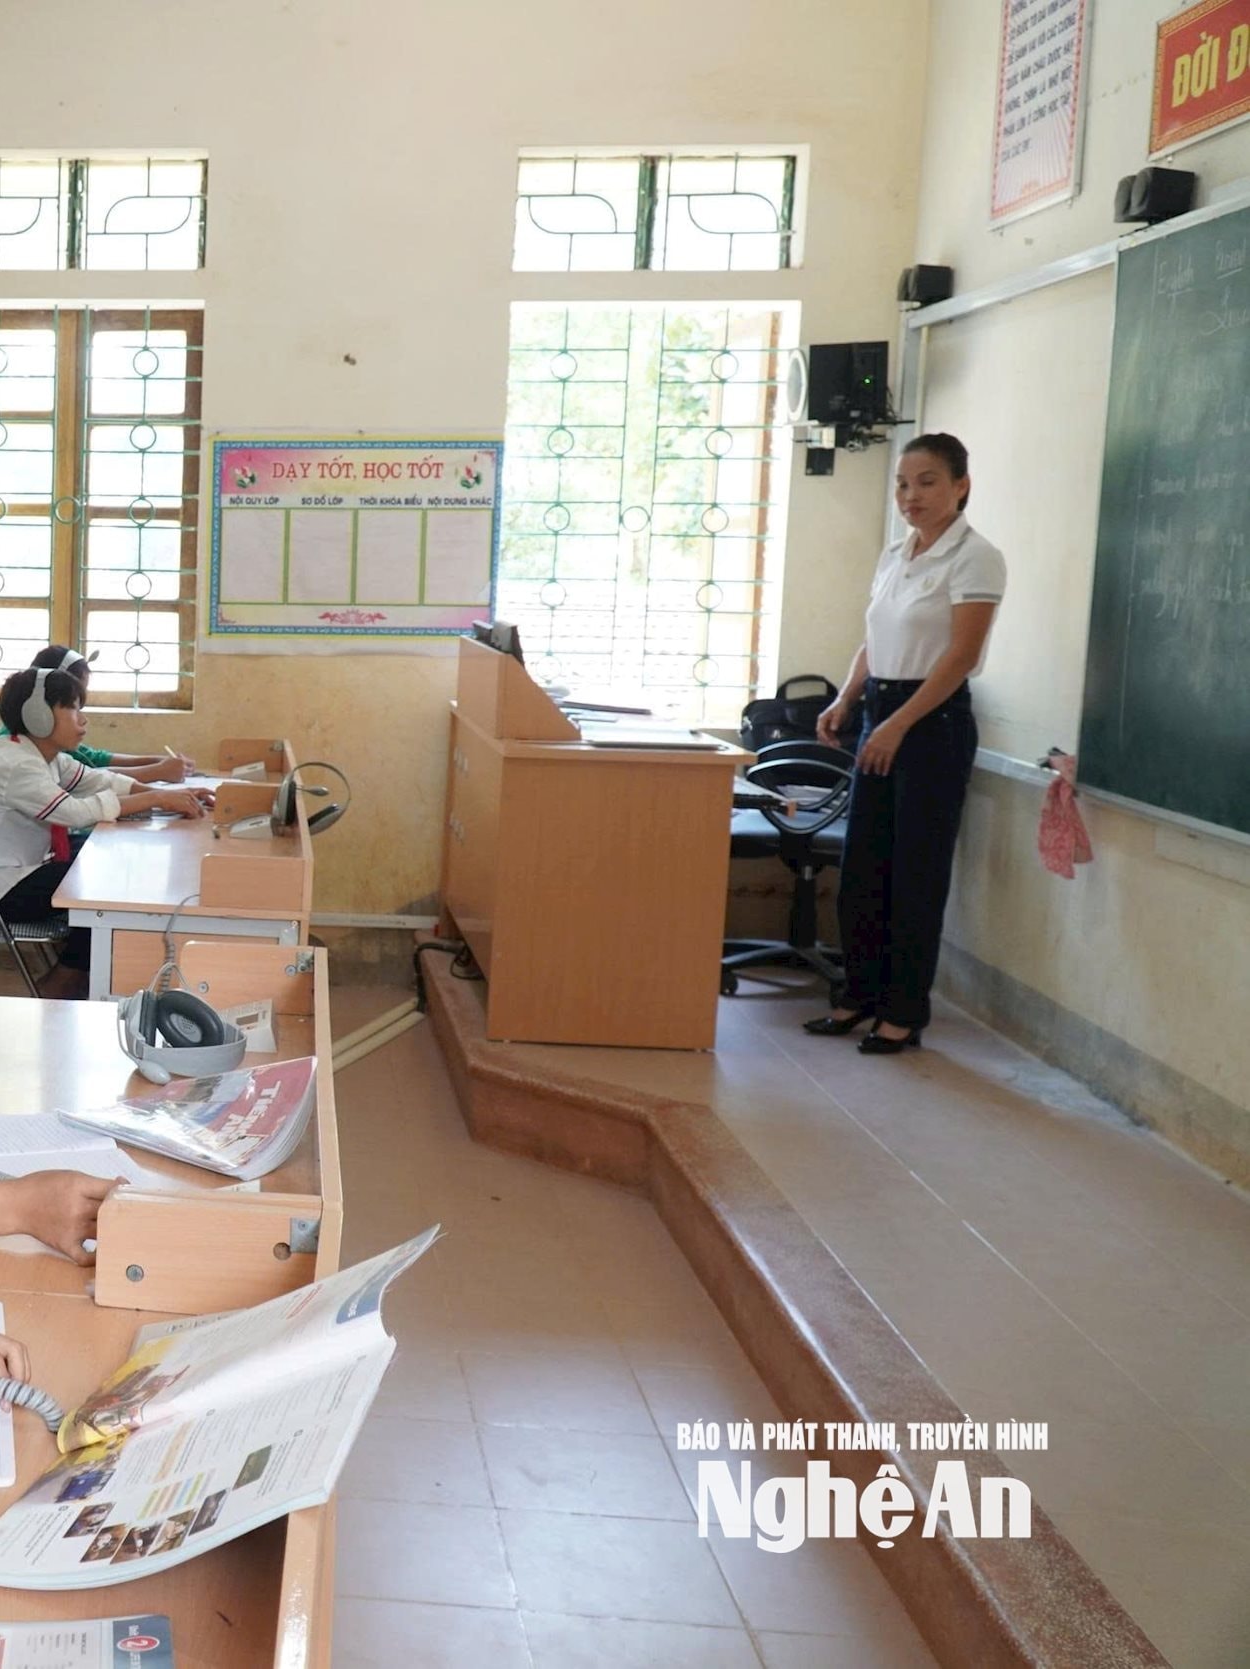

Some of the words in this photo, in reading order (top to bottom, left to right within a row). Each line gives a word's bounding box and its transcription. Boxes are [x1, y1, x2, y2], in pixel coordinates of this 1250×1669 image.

[1172, 31, 1220, 108] ĐỜI
[1227, 24, 1250, 82] Đ
[272, 462, 312, 482] DẠY
[317, 455, 357, 480] TỐT,
[362, 462, 402, 483] HỌC
[407, 455, 444, 479] TỐT
